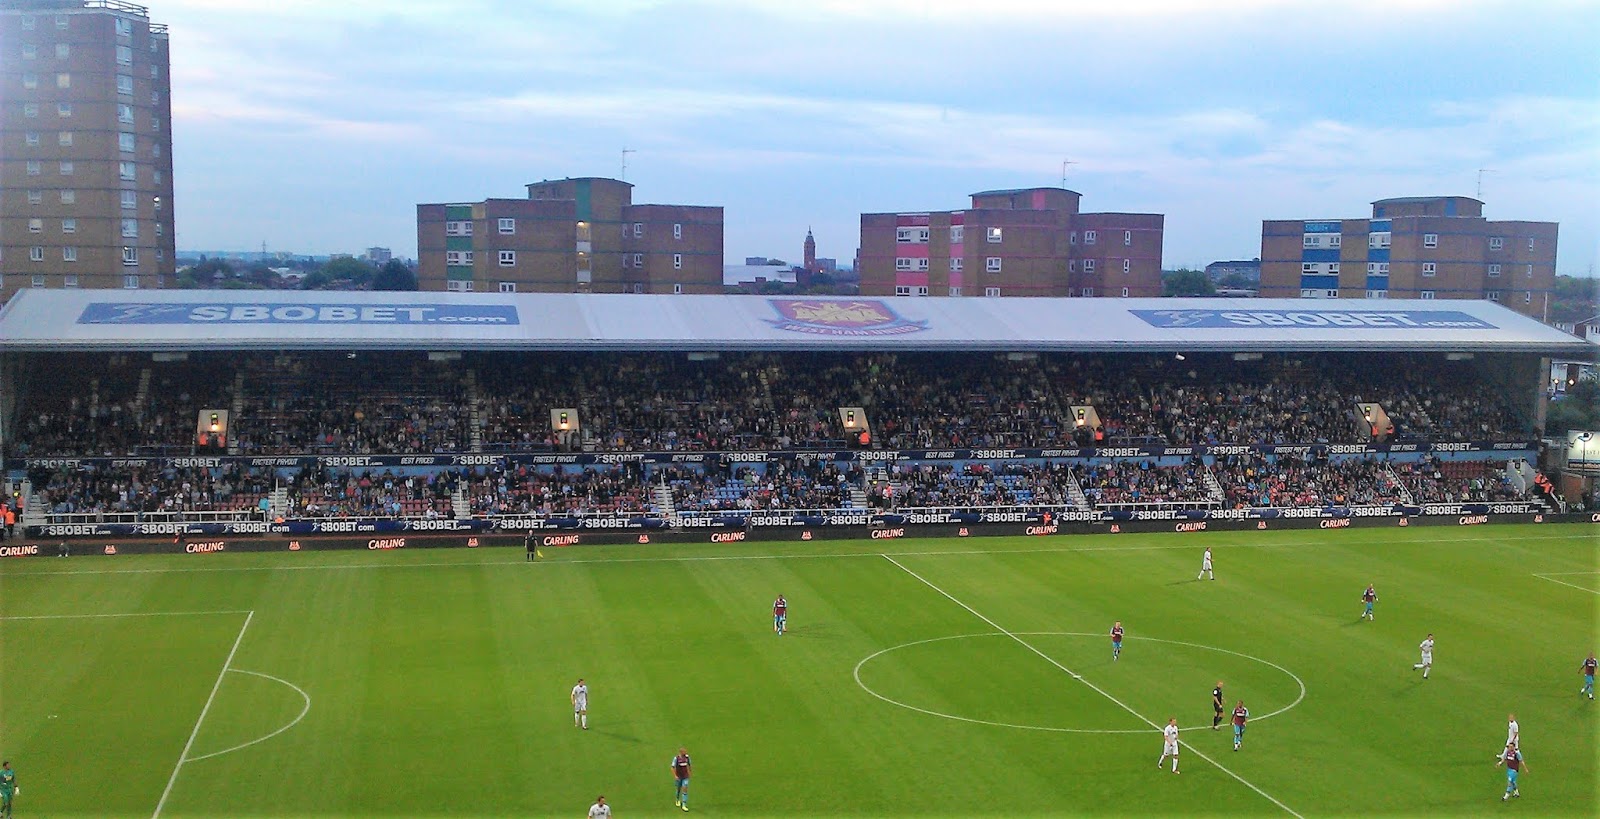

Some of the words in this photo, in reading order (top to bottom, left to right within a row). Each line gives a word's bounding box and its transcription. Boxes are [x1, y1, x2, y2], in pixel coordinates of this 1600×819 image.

[188, 306, 507, 322] SBOBET.com
[1218, 311, 1486, 328] SBOBET.com
[909, 514, 962, 523] SBOBET.com
[987, 513, 1038, 522] SBOBET.com
[1138, 510, 1187, 520] SBOBET.com
[1211, 509, 1260, 519] SBOBET.com
[412, 520, 472, 530] SBOBET.com
[500, 519, 558, 529] SBOBET.com
[585, 519, 641, 528] SBOBET.com
[669, 518, 724, 527] SBOBET.com
[751, 516, 804, 526] SBOBET.com
[830, 516, 884, 525] SBOBET.com
[1320, 519, 1350, 529] CARLING
[1459, 515, 1488, 525] CARLING
[48, 525, 111, 535] SBOBET.com
[141, 524, 203, 534] SBOBET.com
[1026, 525, 1058, 536] CARLING
[1175, 521, 1207, 532] CARLING
[710, 532, 745, 543] CARLING
[871, 528, 905, 539] CARLING
[368, 539, 405, 550] CARLING
[543, 535, 579, 546] CARLING
[0, 545, 38, 557] CARLING
[186, 541, 225, 553] CARLING
